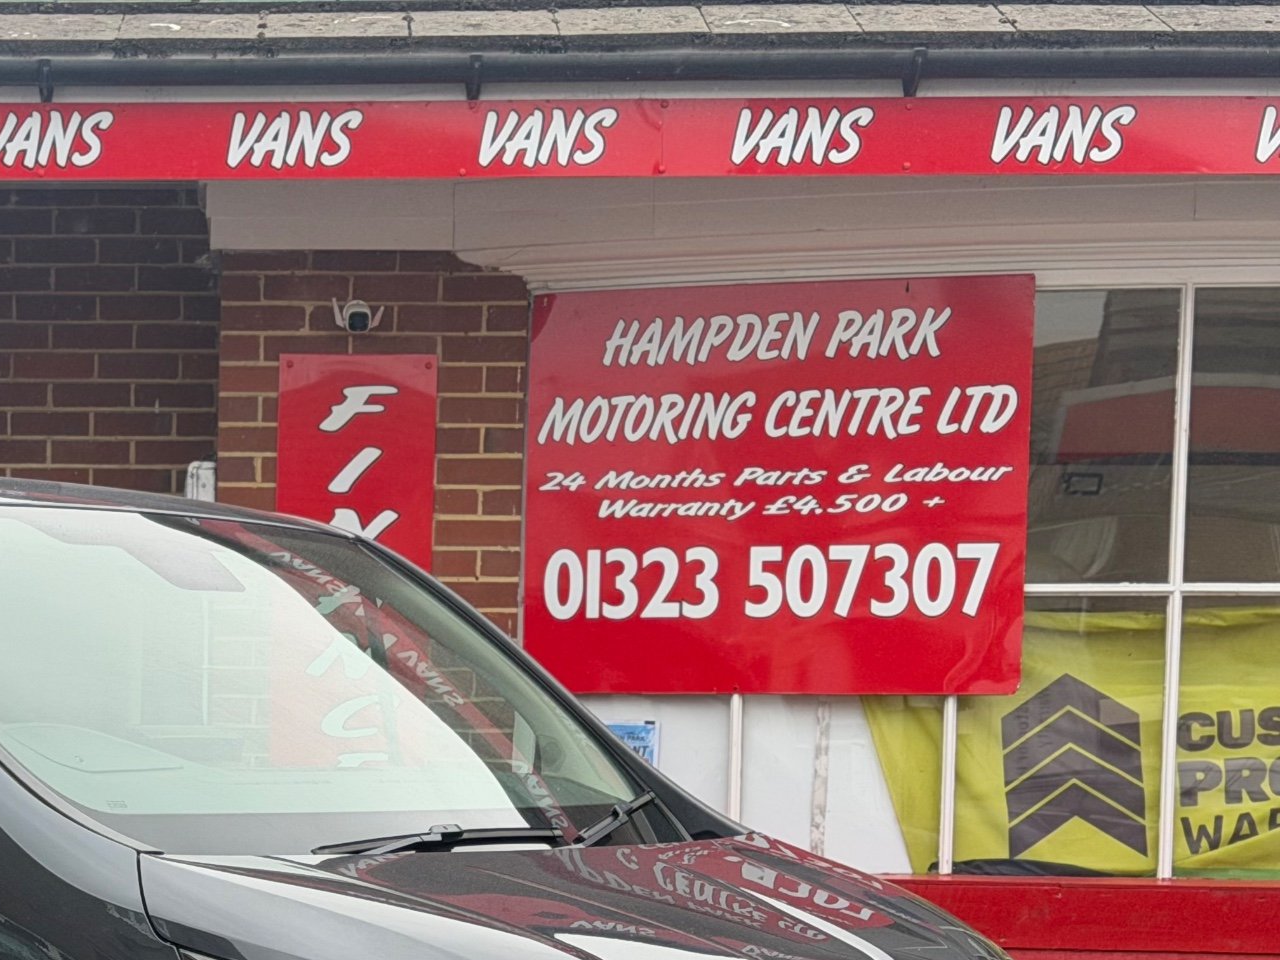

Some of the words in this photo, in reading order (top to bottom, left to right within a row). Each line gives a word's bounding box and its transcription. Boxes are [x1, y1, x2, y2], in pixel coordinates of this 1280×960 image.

[225, 109, 363, 169] VANS
[477, 108, 618, 168] VANS
[729, 105, 875, 165] VANS
[989, 105, 1137, 165] VANS
[603, 311, 820, 367] HAMPDEN
[825, 306, 952, 361] PARK
[537, 390, 756, 446] MOTORING
[765, 386, 931, 440] CENTRE
[936, 383, 1018, 436] LTD
[538, 471, 587, 492] 24
[594, 467, 726, 491] Months
[734, 465, 827, 487] Parts
[837, 463, 871, 485] &
[883, 461, 1015, 484] Labour
[597, 497, 756, 521] Warranty
[543, 545, 720, 620] 01323
[743, 541, 1001, 619] 507307
[1177, 757, 1280, 807] PR
